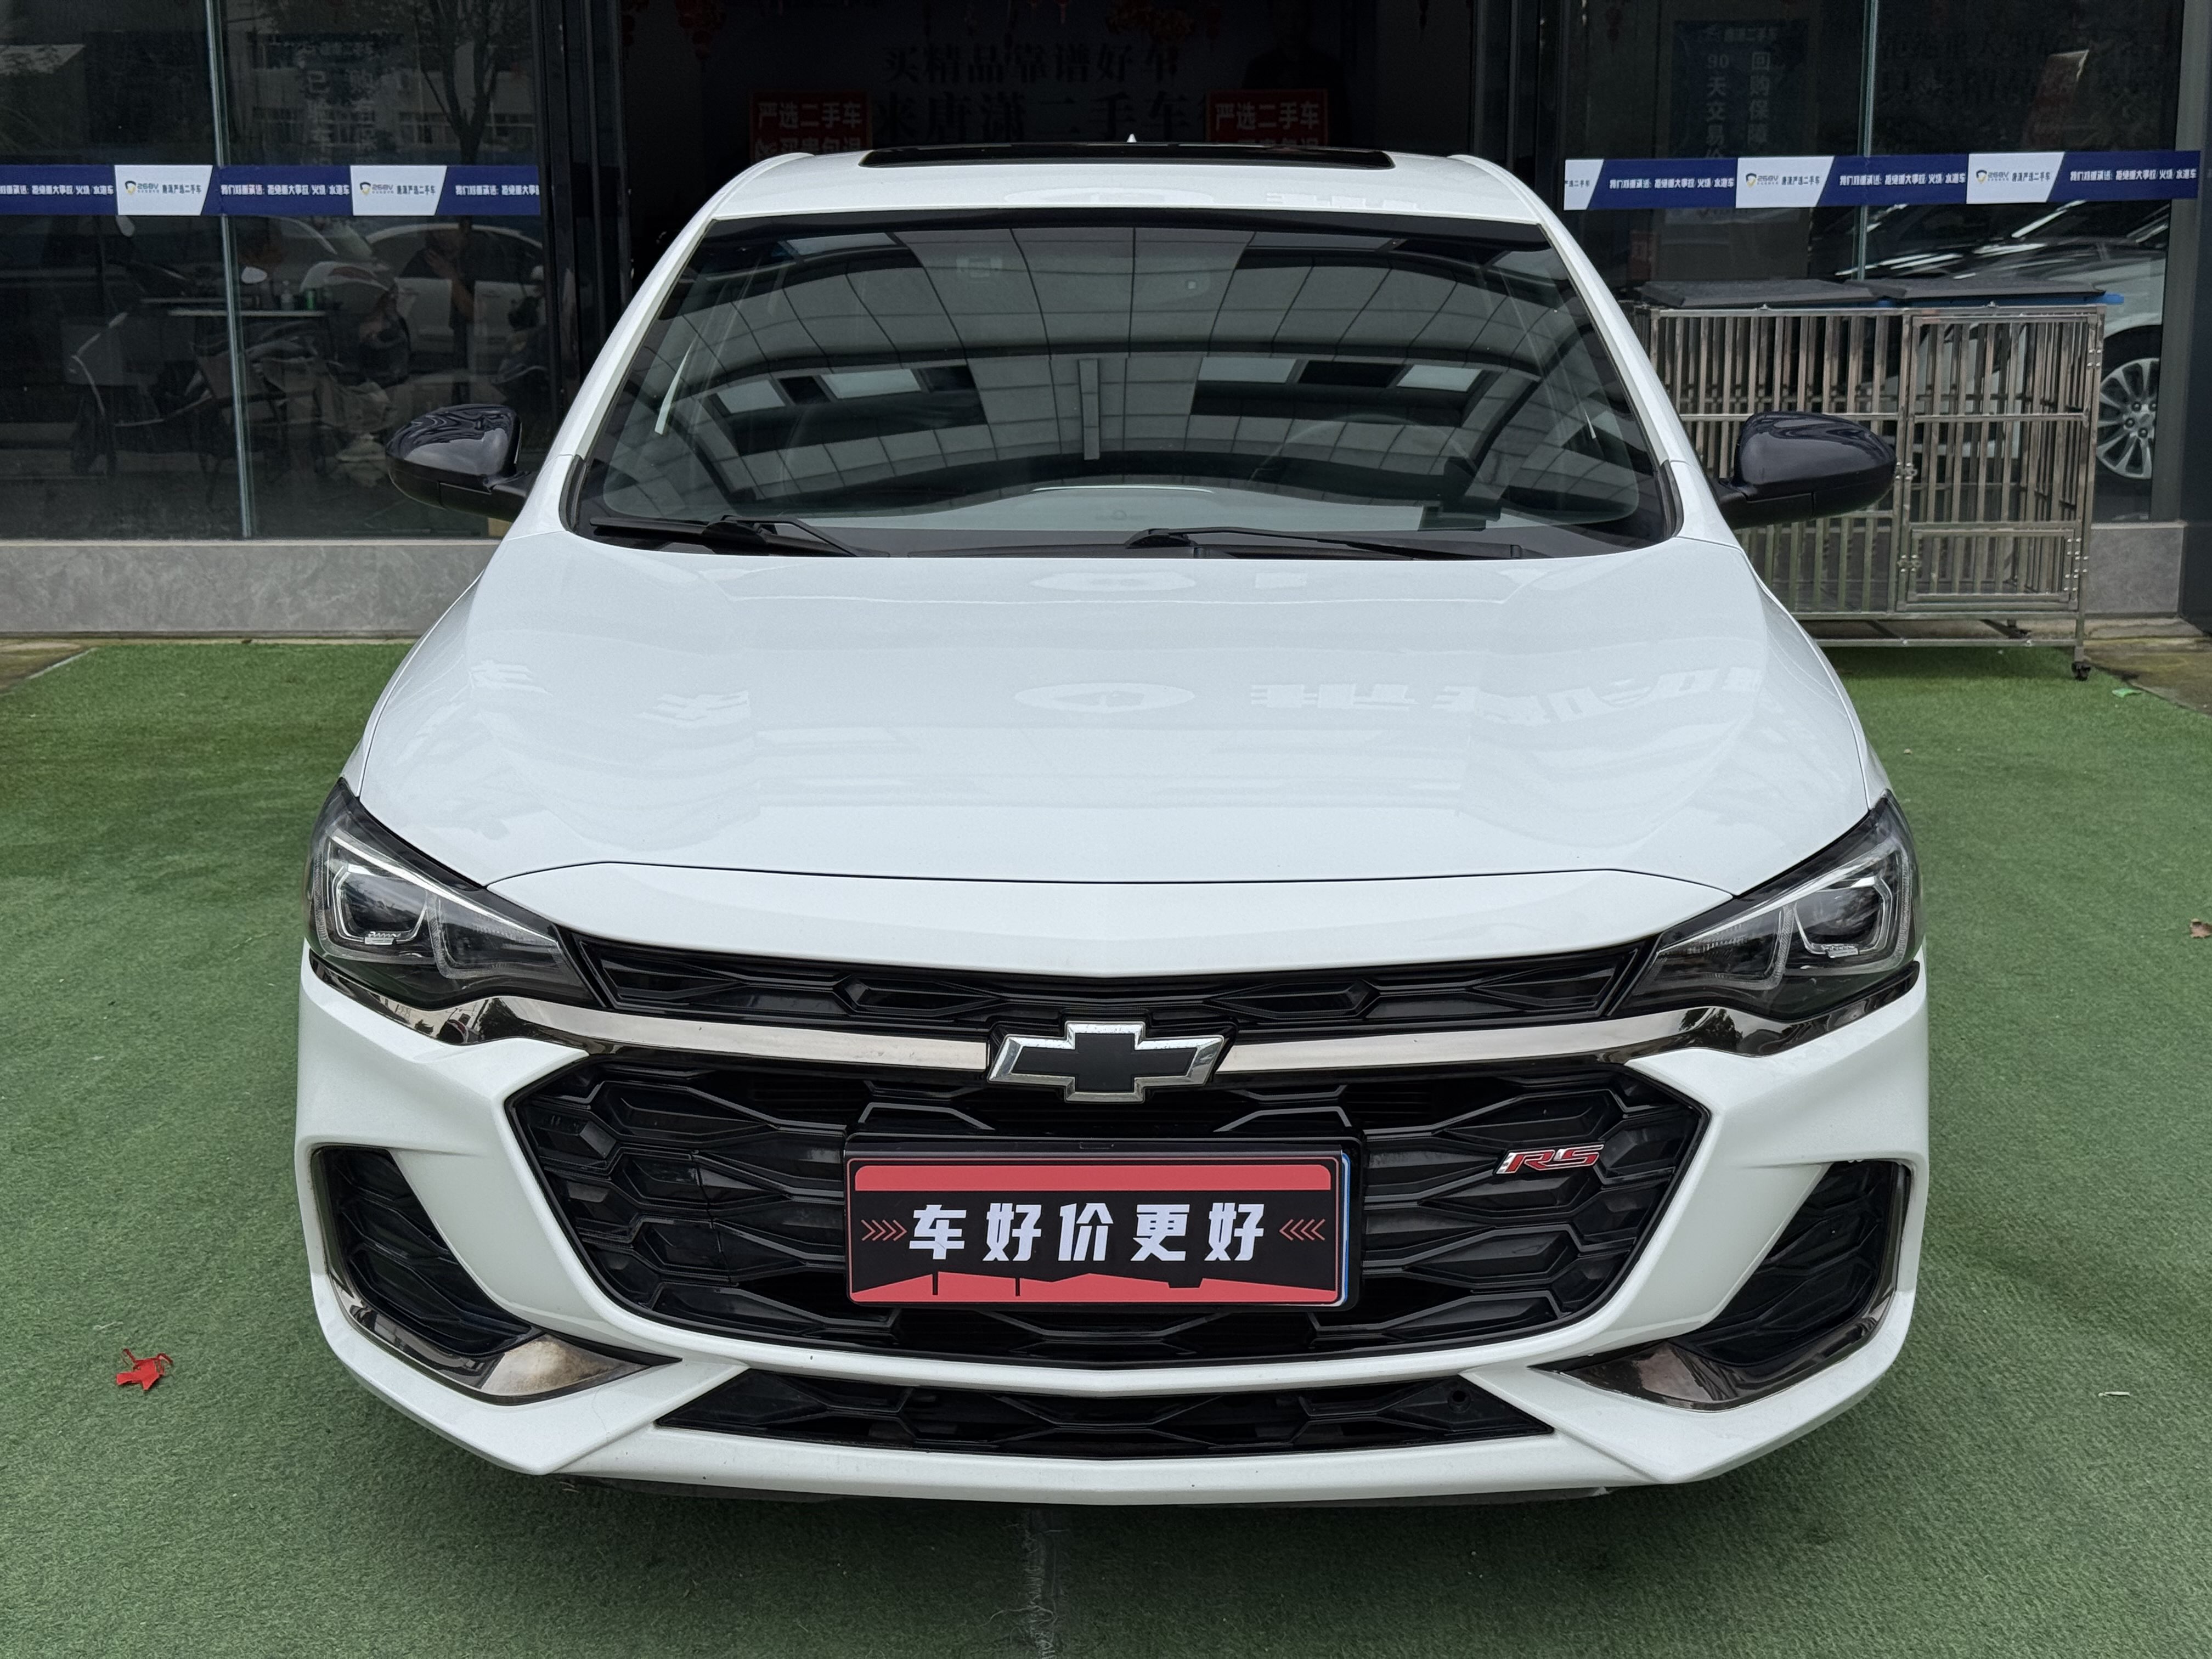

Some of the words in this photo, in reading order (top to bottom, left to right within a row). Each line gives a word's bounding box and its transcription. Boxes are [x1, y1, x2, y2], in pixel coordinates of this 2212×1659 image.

[758, 100, 862, 130] 严选二手车
[873, 91, 1206, 142] 来唐潇二手车
[1215, 100, 1319, 132] 严选二手车
[1496, 1144, 1605, 1175] RS
[909, 1202, 1265, 1262] 车好价更好
